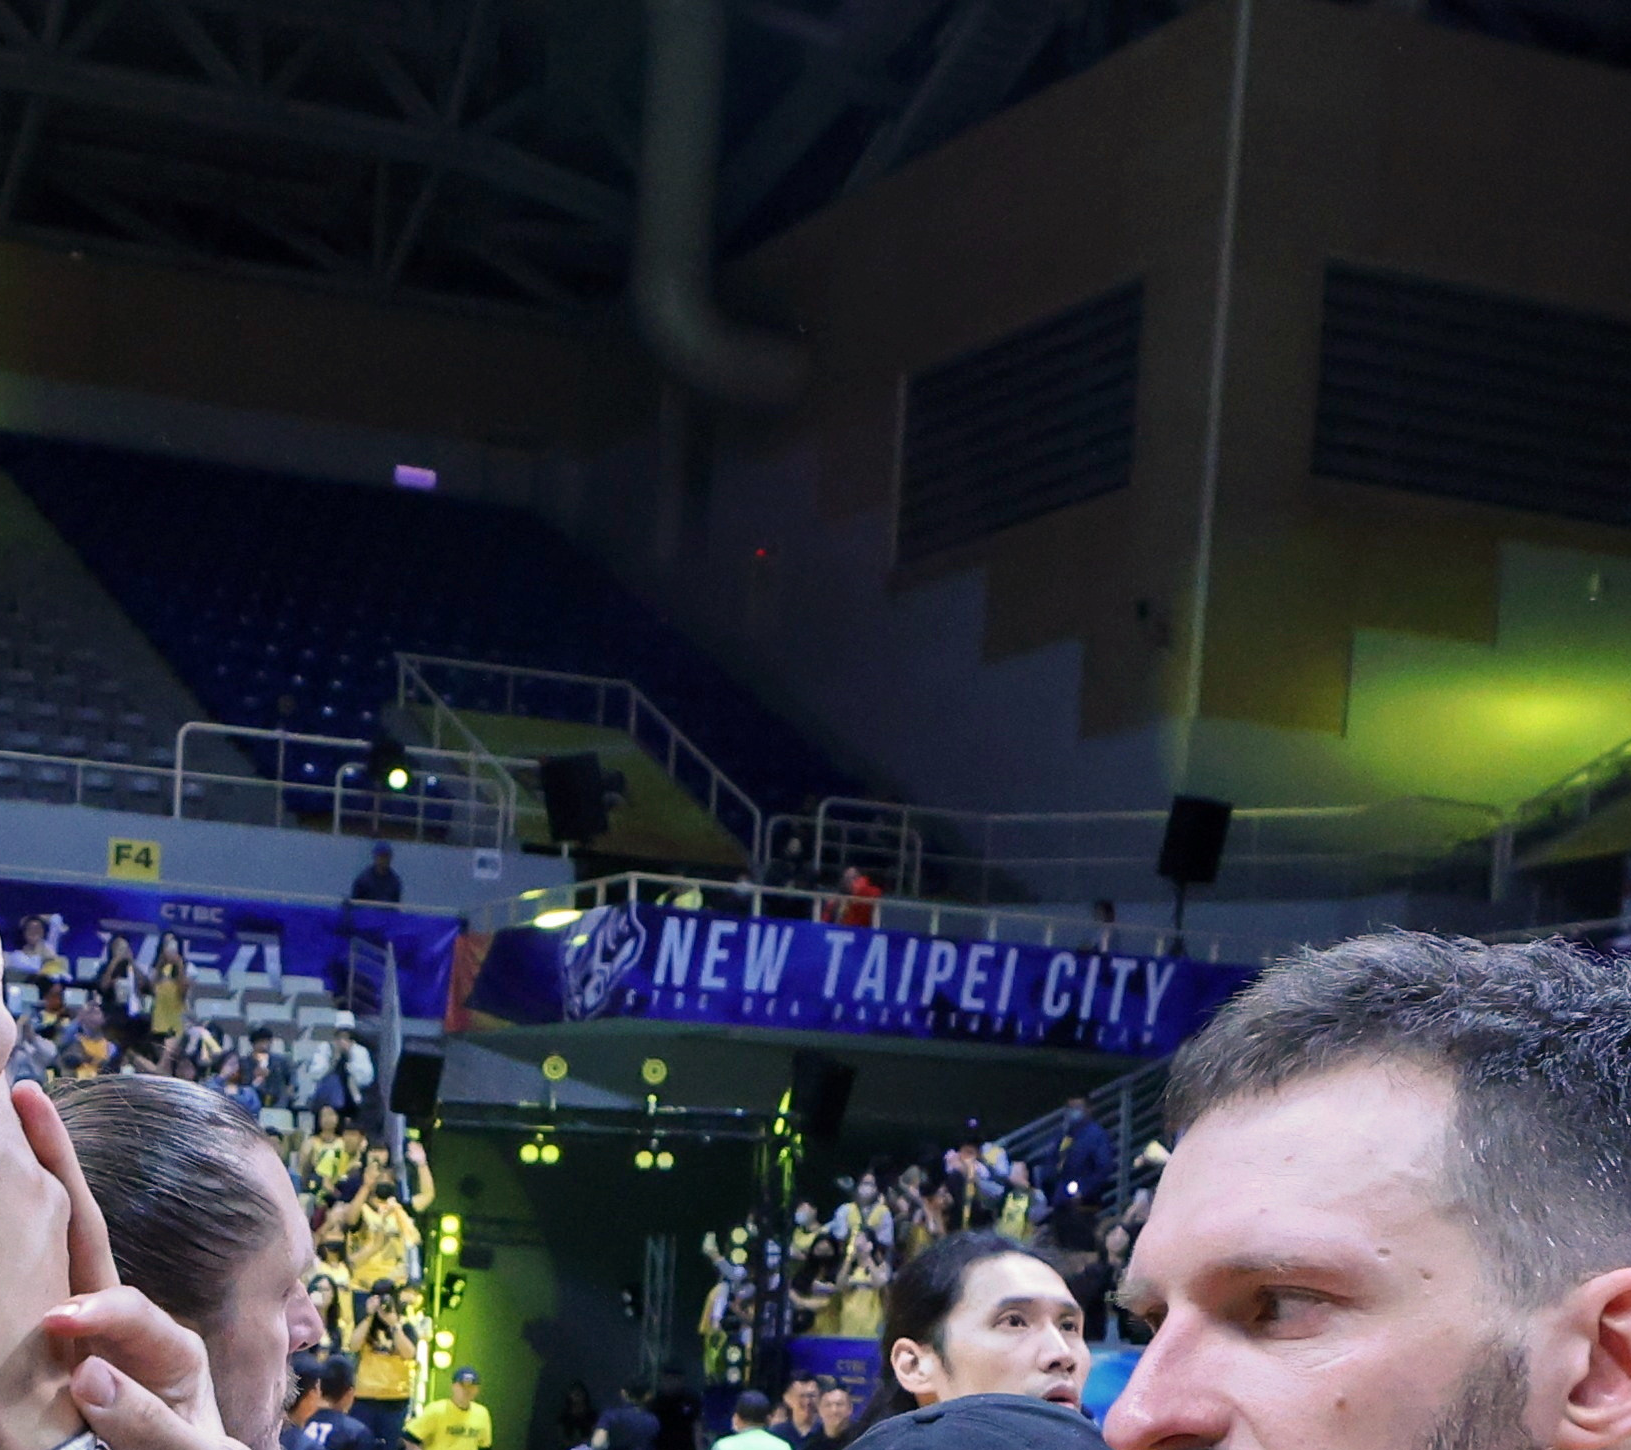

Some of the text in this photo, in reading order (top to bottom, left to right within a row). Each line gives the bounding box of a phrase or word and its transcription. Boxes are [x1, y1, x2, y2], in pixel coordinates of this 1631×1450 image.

[114, 843, 153, 868] F4
[160, 902, 225, 923] CTBC
[653, 916, 1174, 1027] NEW TAIPEI CITY
